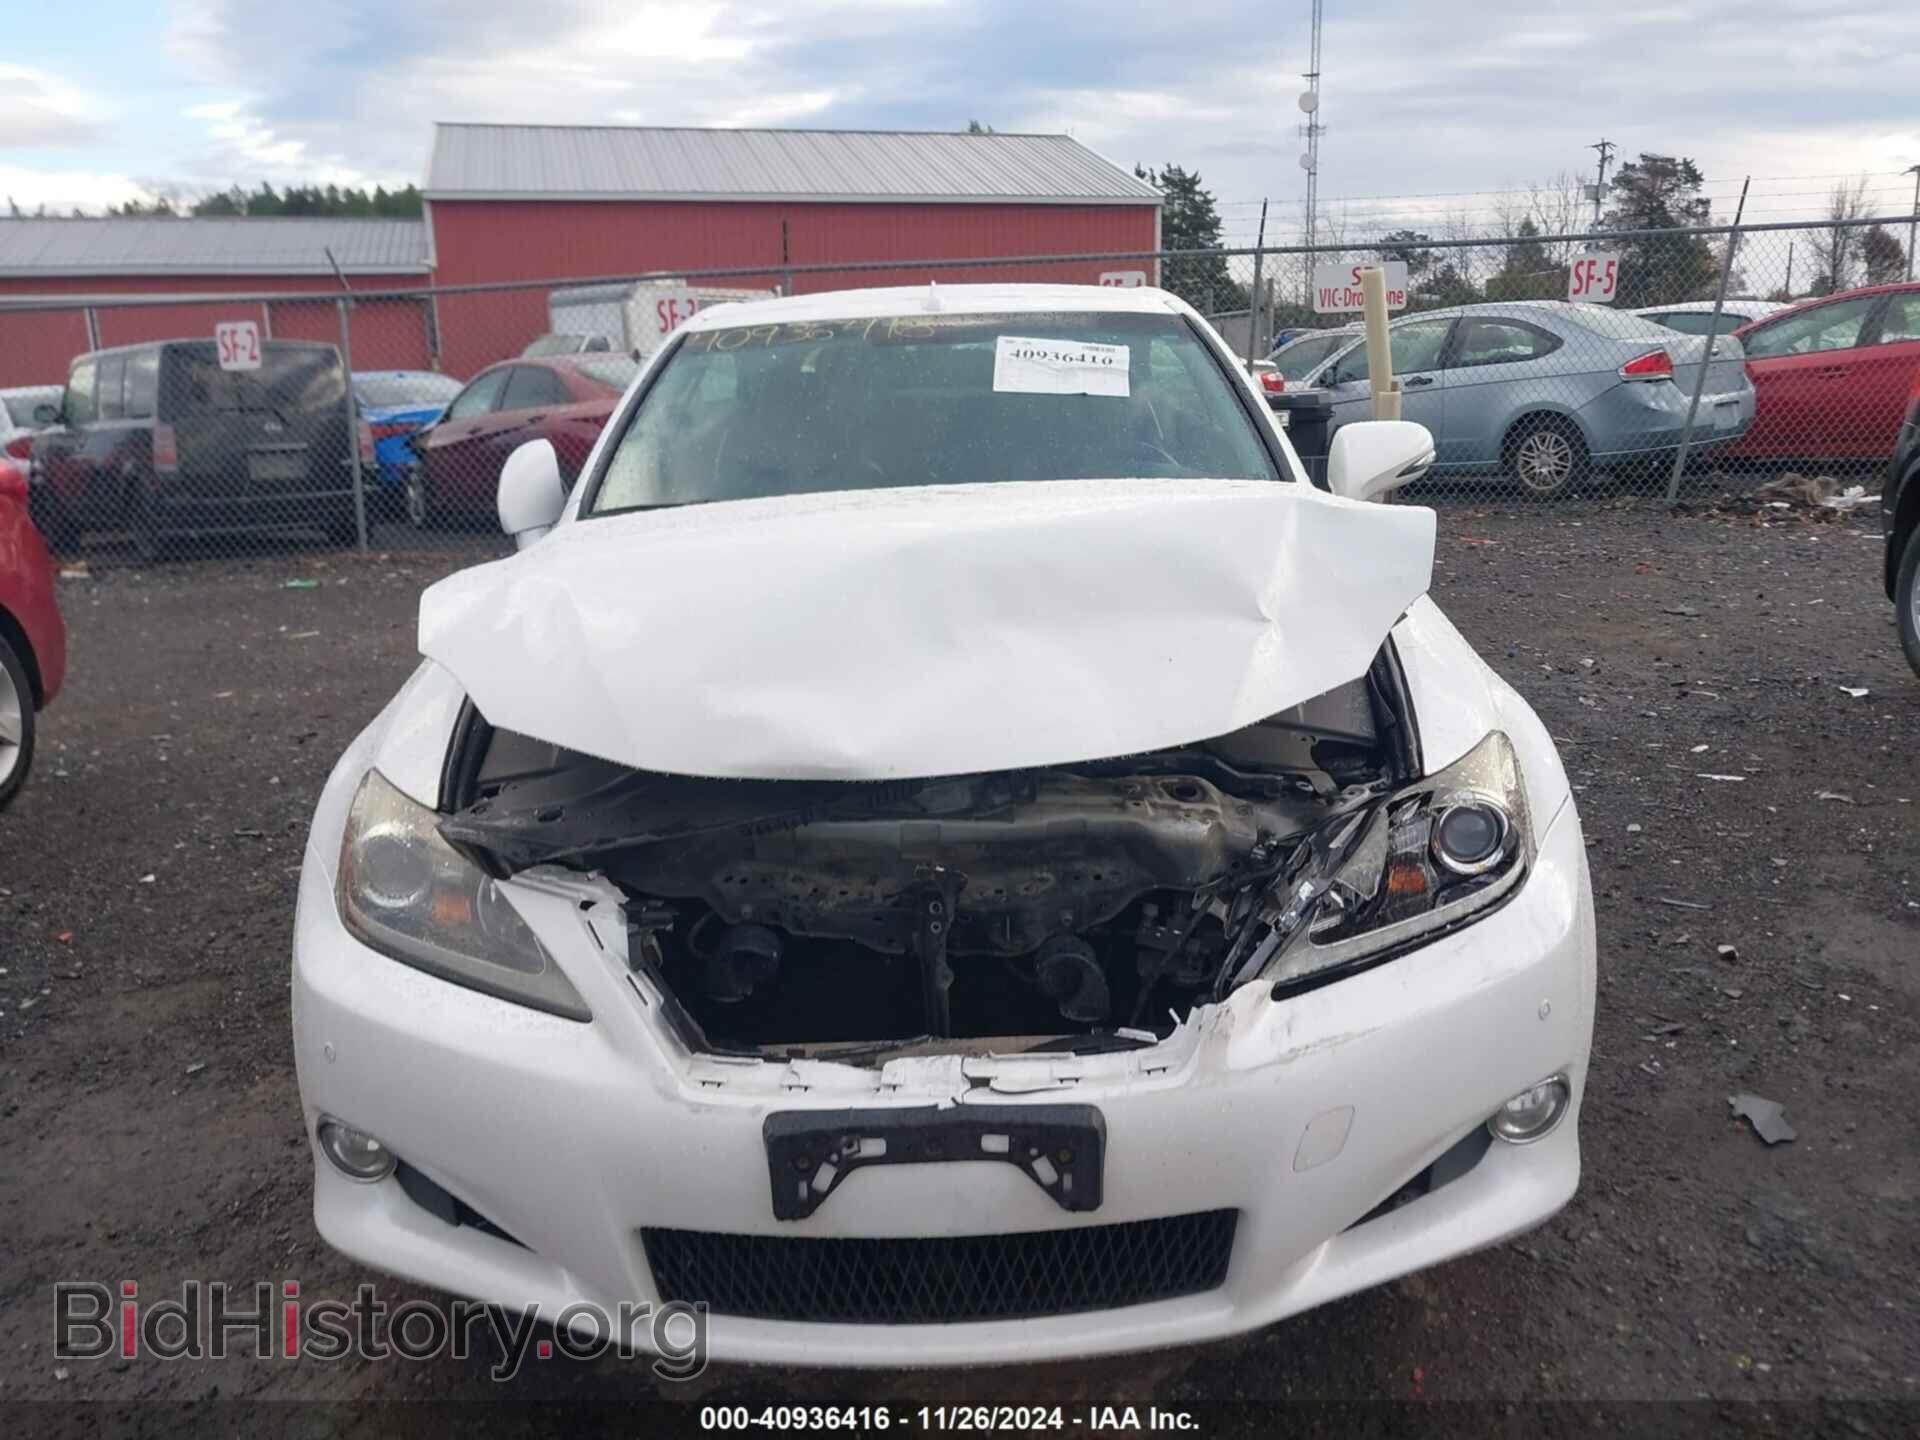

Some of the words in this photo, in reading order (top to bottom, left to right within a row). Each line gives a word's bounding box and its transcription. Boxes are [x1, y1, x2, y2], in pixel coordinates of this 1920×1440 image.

[1351, 266, 1374, 286] S
[1572, 260, 1616, 295] SF-5
[220, 329, 258, 362] SF-2
